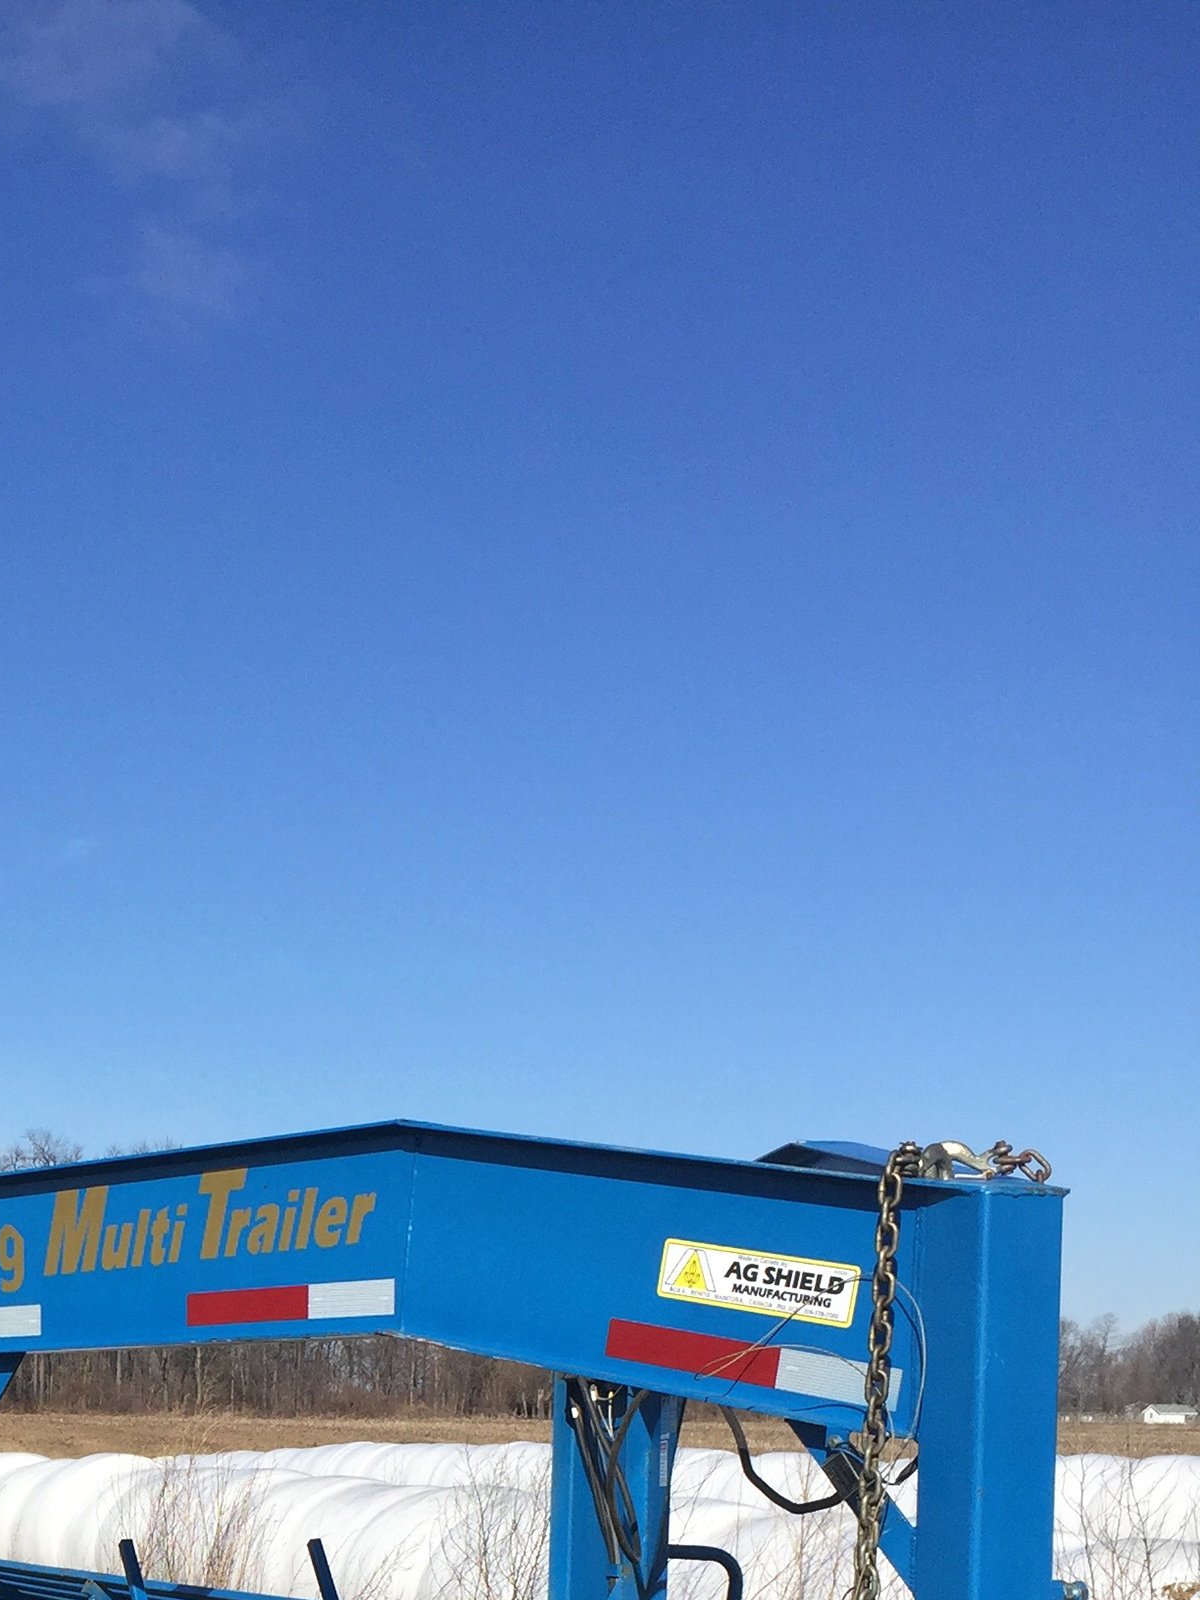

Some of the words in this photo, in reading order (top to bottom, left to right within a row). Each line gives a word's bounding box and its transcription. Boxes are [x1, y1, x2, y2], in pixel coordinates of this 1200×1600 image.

[44, 1185, 188, 1276] Multi
[199, 1168, 377, 1260] Trailer
[724, 1261, 760, 1282] AG
[763, 1266, 845, 1295] SHIELD
[731, 1283, 832, 1308] MANUFACTURING
